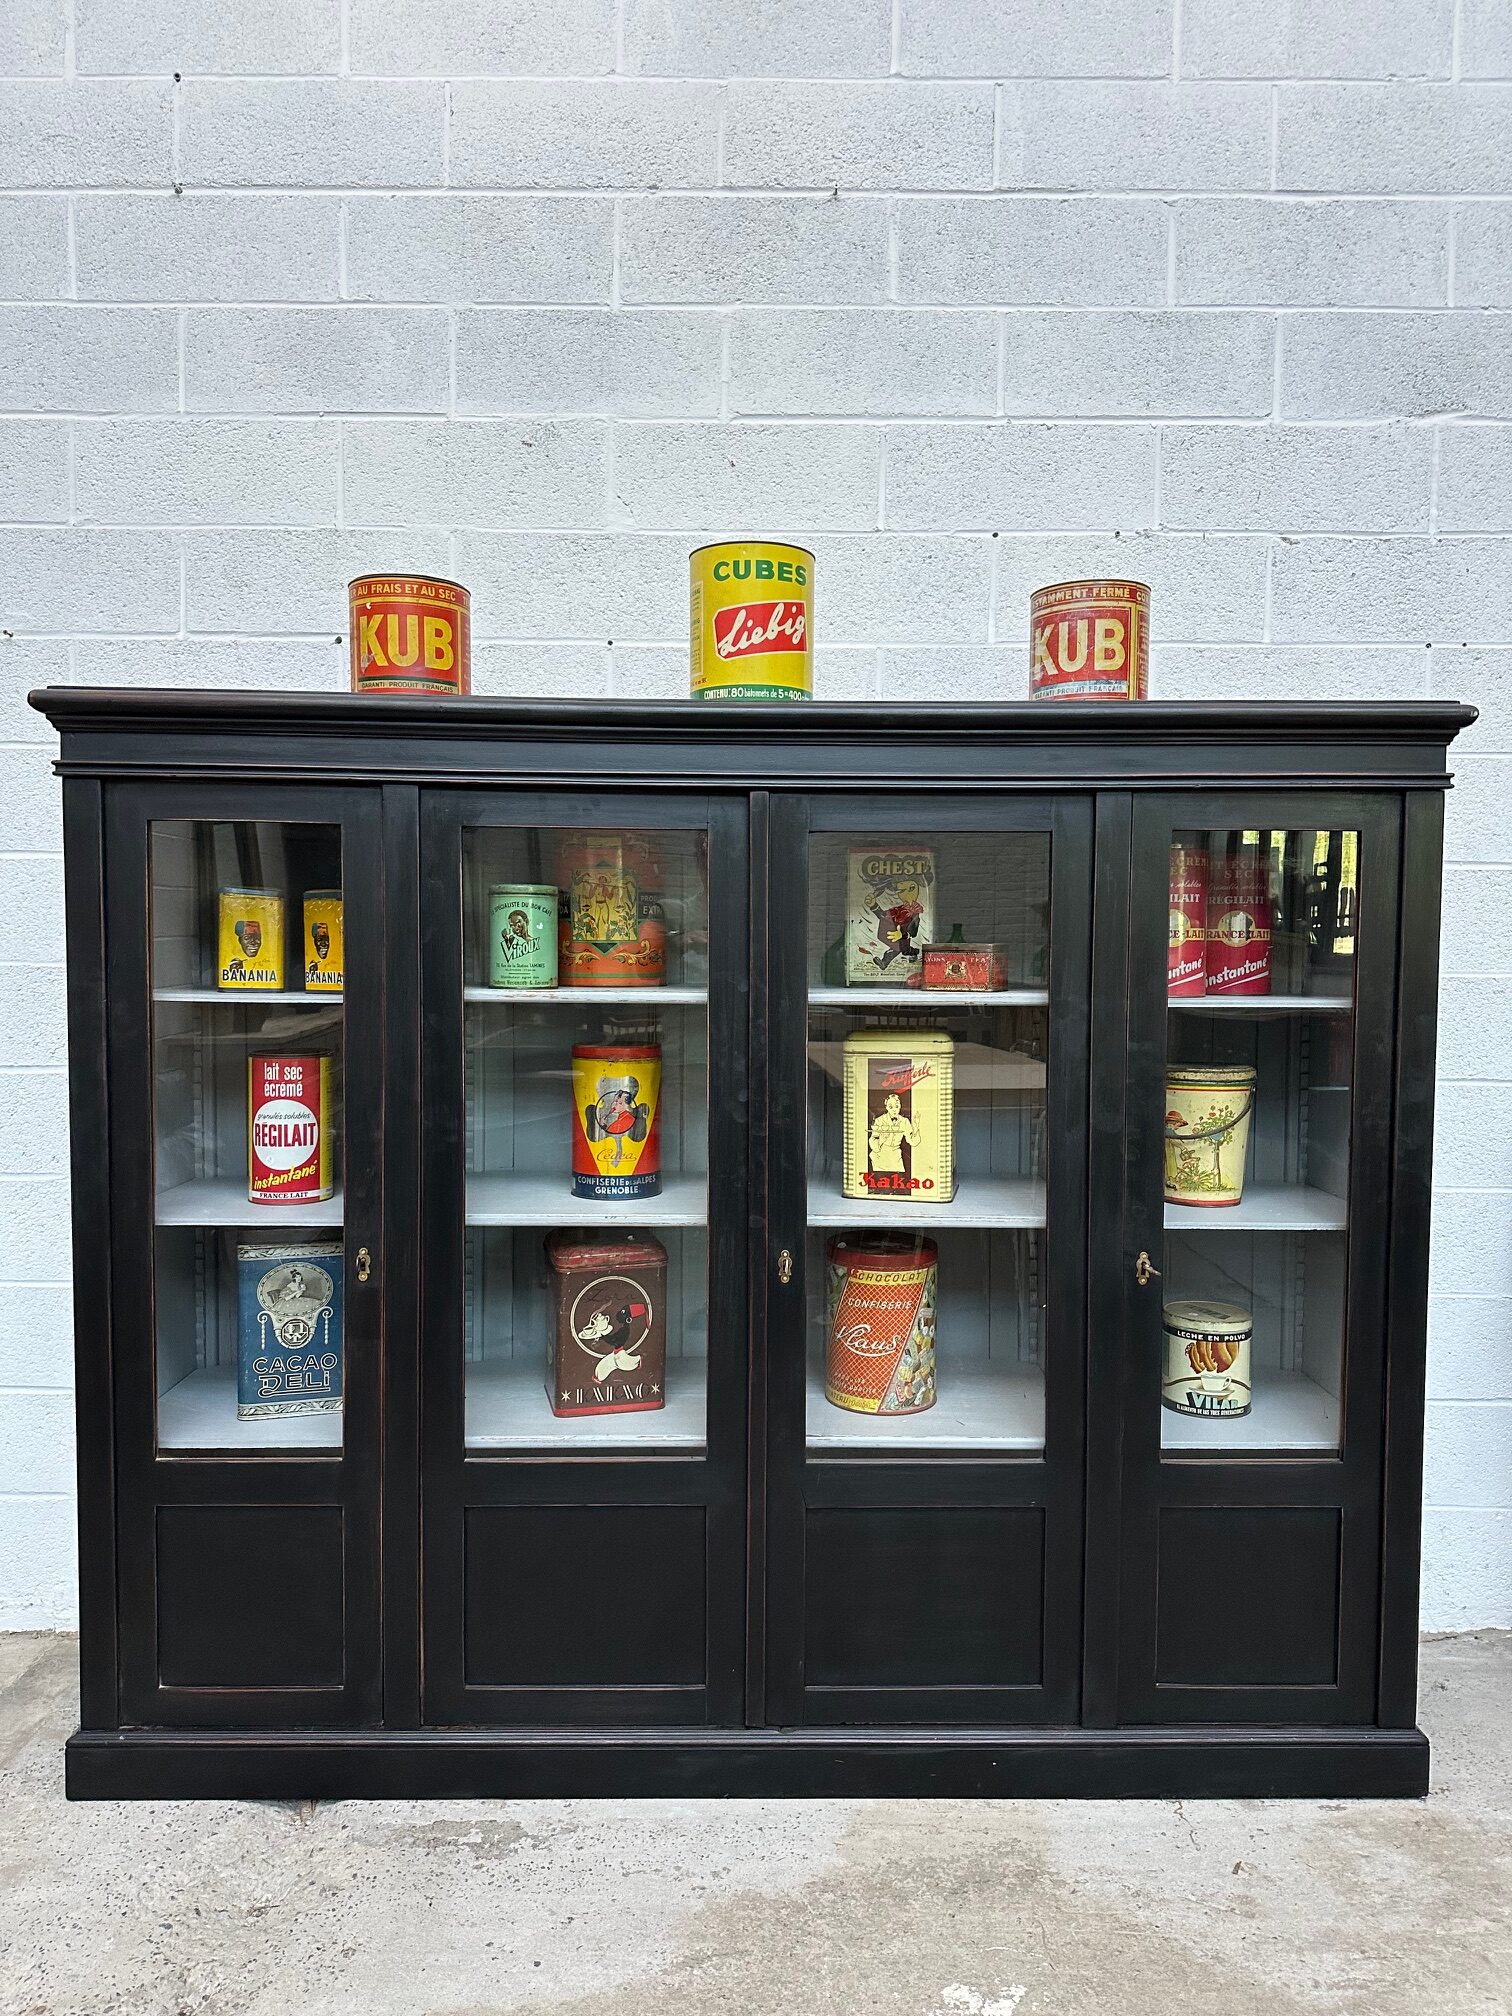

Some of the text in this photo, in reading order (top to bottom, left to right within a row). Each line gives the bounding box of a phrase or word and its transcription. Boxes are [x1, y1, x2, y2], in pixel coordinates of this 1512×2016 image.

[713, 559, 807, 587] CUBES
[357, 585, 367, 596] AU
[371, 583, 401, 593] FRAIS
[405, 584, 418, 593] ET
[421, 585, 435, 597] AU
[438, 589, 456, 602] SEC
[717, 602, 805, 656] Liebig
[360, 613, 454, 671] KUB
[1033, 618, 1126, 679] KUB
[422, 683, 453, 693] FRANÇAIS
[867, 859, 925, 876] CHEST
[222, 969, 277, 982] BANANIA
[306, 972, 343, 984] BANANIA
[264, 1063, 303, 1081] lait sec
[264, 1081, 303, 1097] écrémé
[284, 1112, 311, 1120] solubles
[254, 1160, 318, 1190] instantané
[578, 1175, 625, 1187] CONFISERIE
[636, 1174, 656, 1184] ALPES
[858, 1172, 935, 1191] Kakao
[595, 1186, 638, 1195] GRENOBLE
[858, 1272, 923, 1283] CHOCOLAT
[848, 1298, 913, 1310] CONFISERIE
[1177, 1331, 1204, 1340] LECHE
[1224, 1333, 1246, 1342] POLVO
[253, 1353, 337, 1374] CACAO
[1186, 1391, 1239, 1409] VILAR
